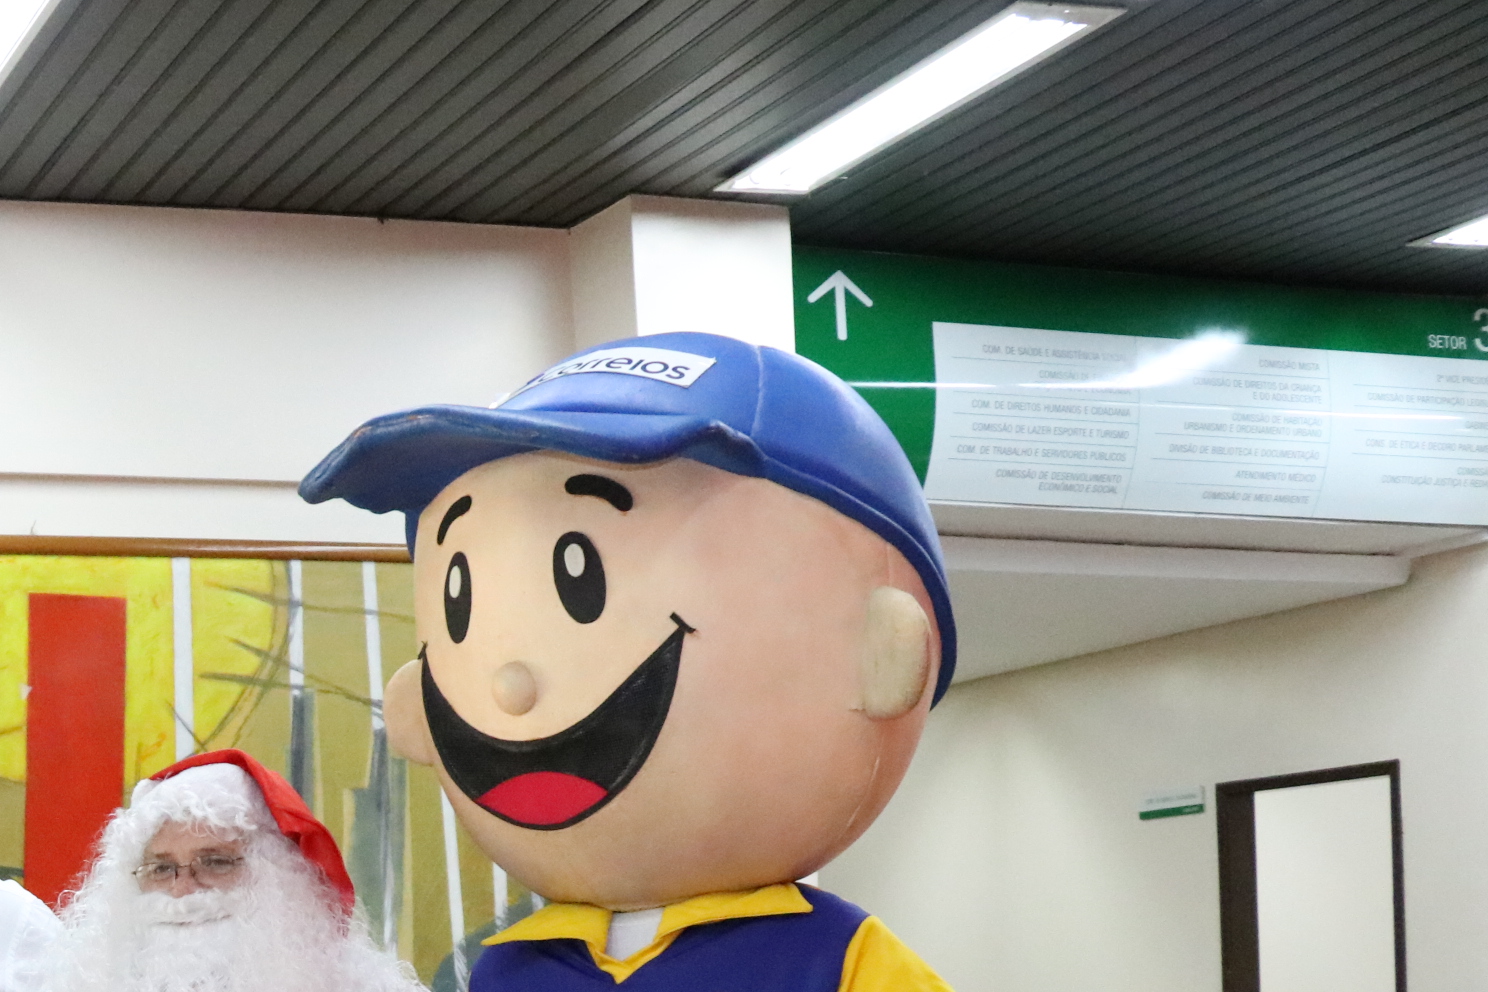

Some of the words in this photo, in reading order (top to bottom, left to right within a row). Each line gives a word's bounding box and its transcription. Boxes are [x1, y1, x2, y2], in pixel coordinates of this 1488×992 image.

[1429, 335, 1467, 350] SETOR
[1006, 347, 1015, 355] DE
[1259, 360, 1296, 370] COMISSÃO
[1299, 363, 1320, 371] MISTA
[1194, 377, 1230, 387] COMISSÃO
[1233, 380, 1242, 388] DE
[1245, 381, 1277, 390] DIREITOS
[1292, 383, 1322, 394] CRIANÇA
[1272, 393, 1322, 404] ADOLESCENTE
[1368, 393, 1404, 402] COMISSÃO
[1407, 395, 1415, 403] DE
[1418, 396, 1465, 407] PARTICIPAÇÃO
[995, 402, 1005, 410] DE
[1008, 403, 1041, 412] DIREITOS
[1045, 405, 1082, 414] HUMANOS
[1084, 407, 1089, 415] E
[1092, 407, 1131, 417] CIDADANIA
[1232, 414, 1270, 423] COMISSÃO
[1272, 416, 1281, 424] DE
[1284, 417, 1322, 427] HABITAÇÃO
[973, 422, 1013, 432] COMISSÃO
[1016, 425, 1025, 433] DE
[1028, 426, 1051, 435] LAZER
[1054, 427, 1087, 437] ESPORTE
[1089, 429, 1094, 437] E
[1097, 430, 1129, 439] TURISMO
[1184, 422, 1227, 432] URBANISMO
[1237, 425, 1290, 435] ORDENAMENTO
[1293, 429, 1322, 437] URBANO
[981, 446, 990, 454] DE
[993, 447, 1033, 457] TRABALHO
[1034, 448, 1039, 457] E
[1042, 449, 1087, 459] SERVIDORES
[1169, 444, 1197, 453] DIVISÃO
[1200, 446, 1209, 454] DE
[1212, 447, 1252, 456] BIBLIOTECA
[1254, 449, 1259, 457] E
[1262, 449, 1319, 461] DOCUMENTAÇÃO
[1421, 442, 1426, 450] E
[1429, 443, 1456, 451] DECORO
[996, 469, 1036, 479] COMISSÃO
[1039, 471, 1048, 480] DE
[1052, 472, 1122, 483] DESENVOLVIMENTO
[1235, 471, 1286, 480] ATENDIMENTO
[1382, 475, 1433, 486] CONSTITUIÇÃO
[1463, 479, 1468, 487] E
[1039, 482, 1084, 492] ECONÔMICO
[1092, 485, 1117, 494] SOCIAL
[1203, 491, 1241, 501] COMISSÃO
[1254, 494, 1272, 502] MEIO
[1274, 495, 1309, 504] AMBIENTE
